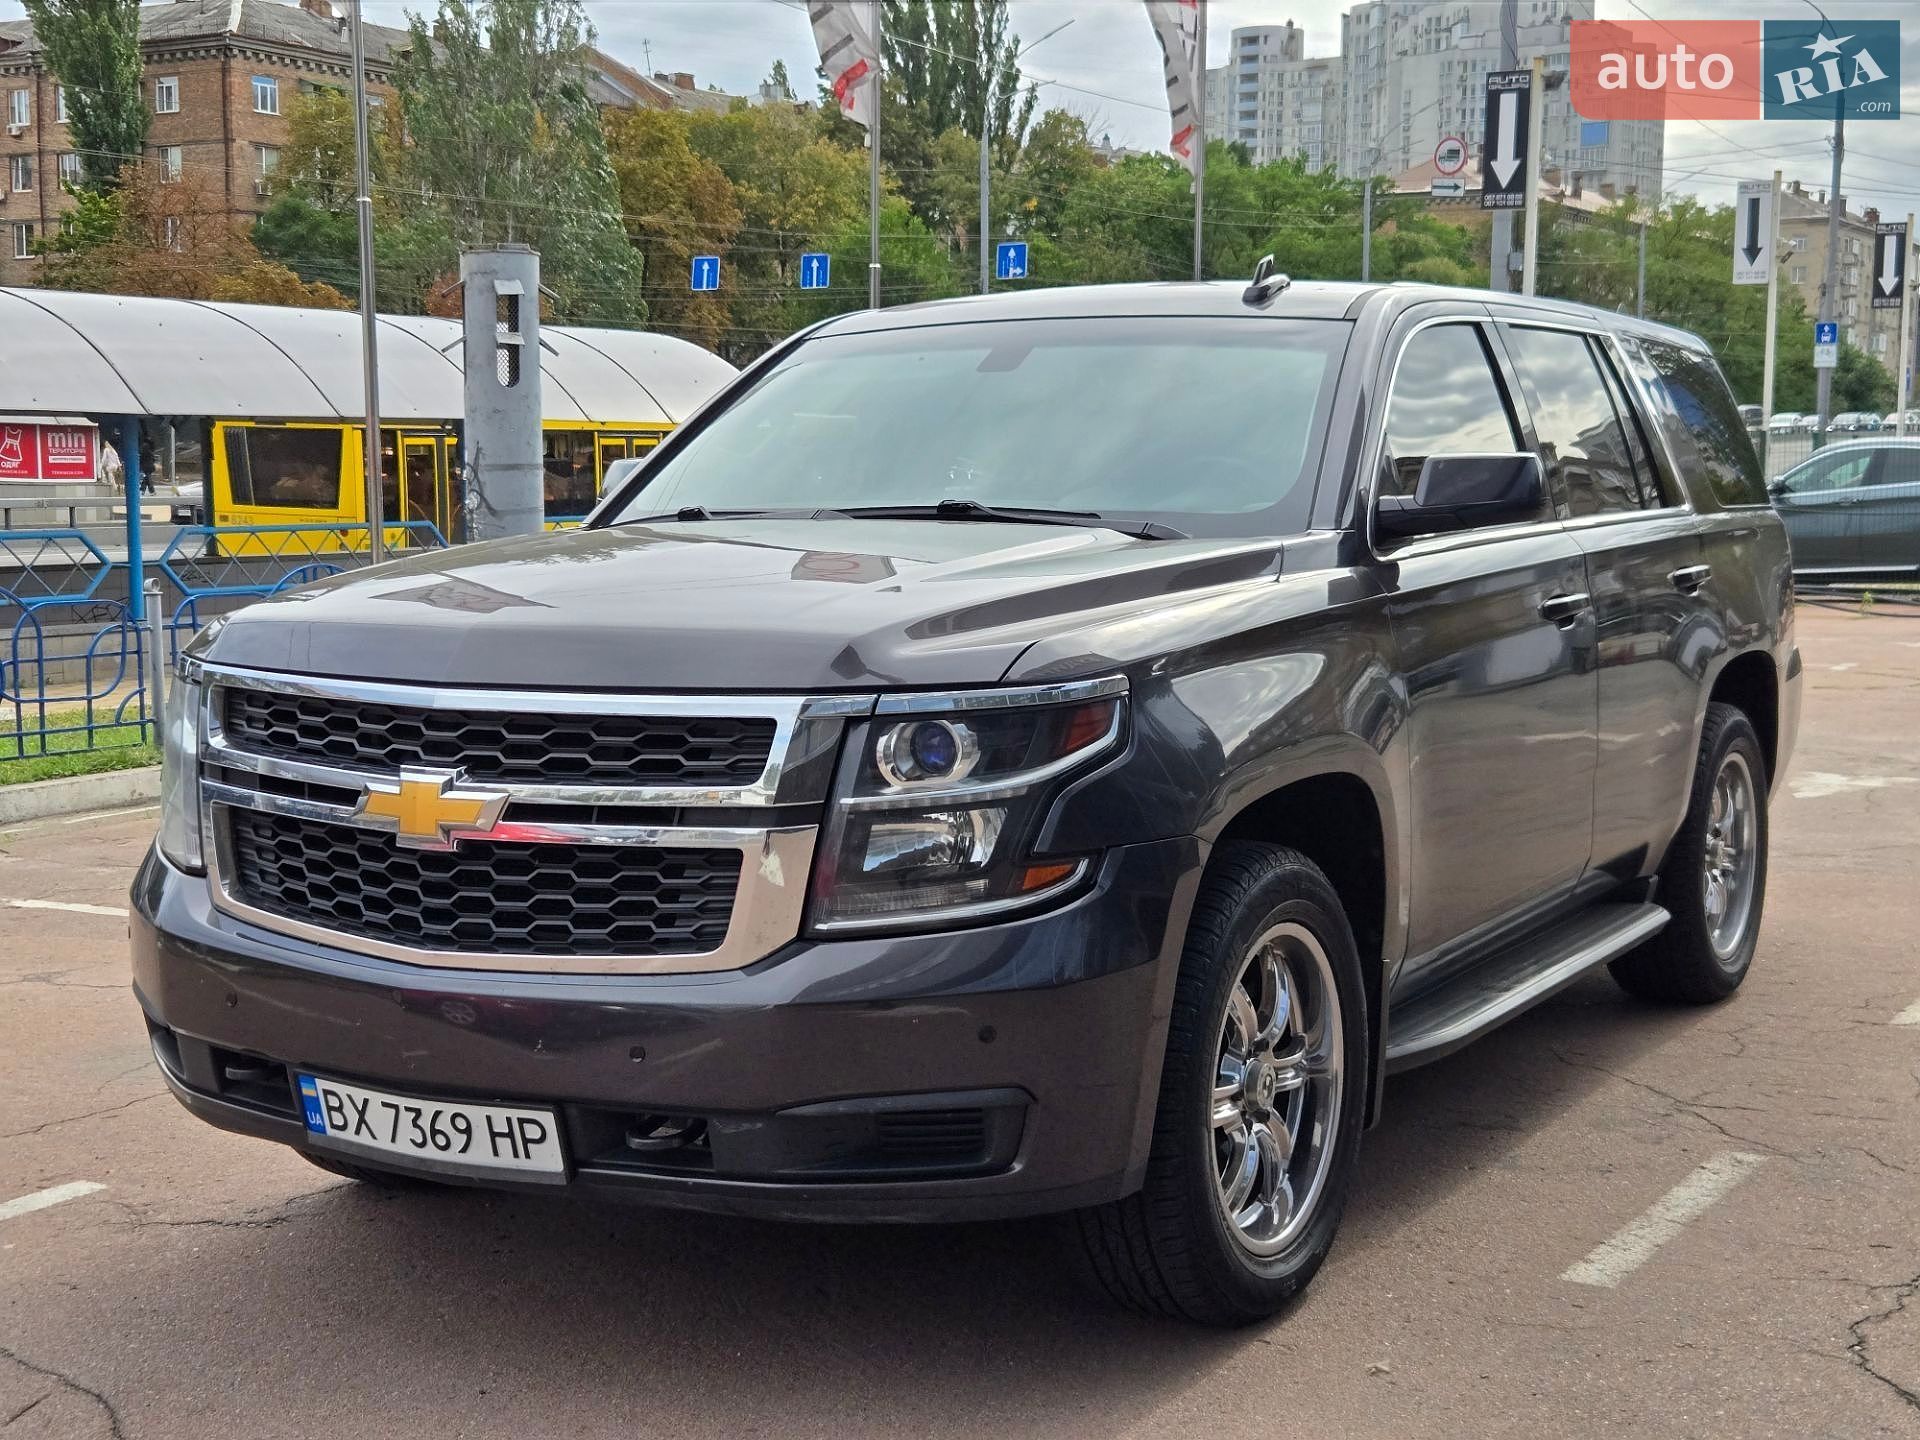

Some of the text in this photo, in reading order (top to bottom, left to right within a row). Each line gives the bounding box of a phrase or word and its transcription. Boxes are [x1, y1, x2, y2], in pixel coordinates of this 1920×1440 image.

[1488, 75, 1529, 84] AUTO
[47, 427, 86, 448] min
[307, 1111, 324, 1127] UA
[322, 1089, 547, 1159] BX 7369 HP
